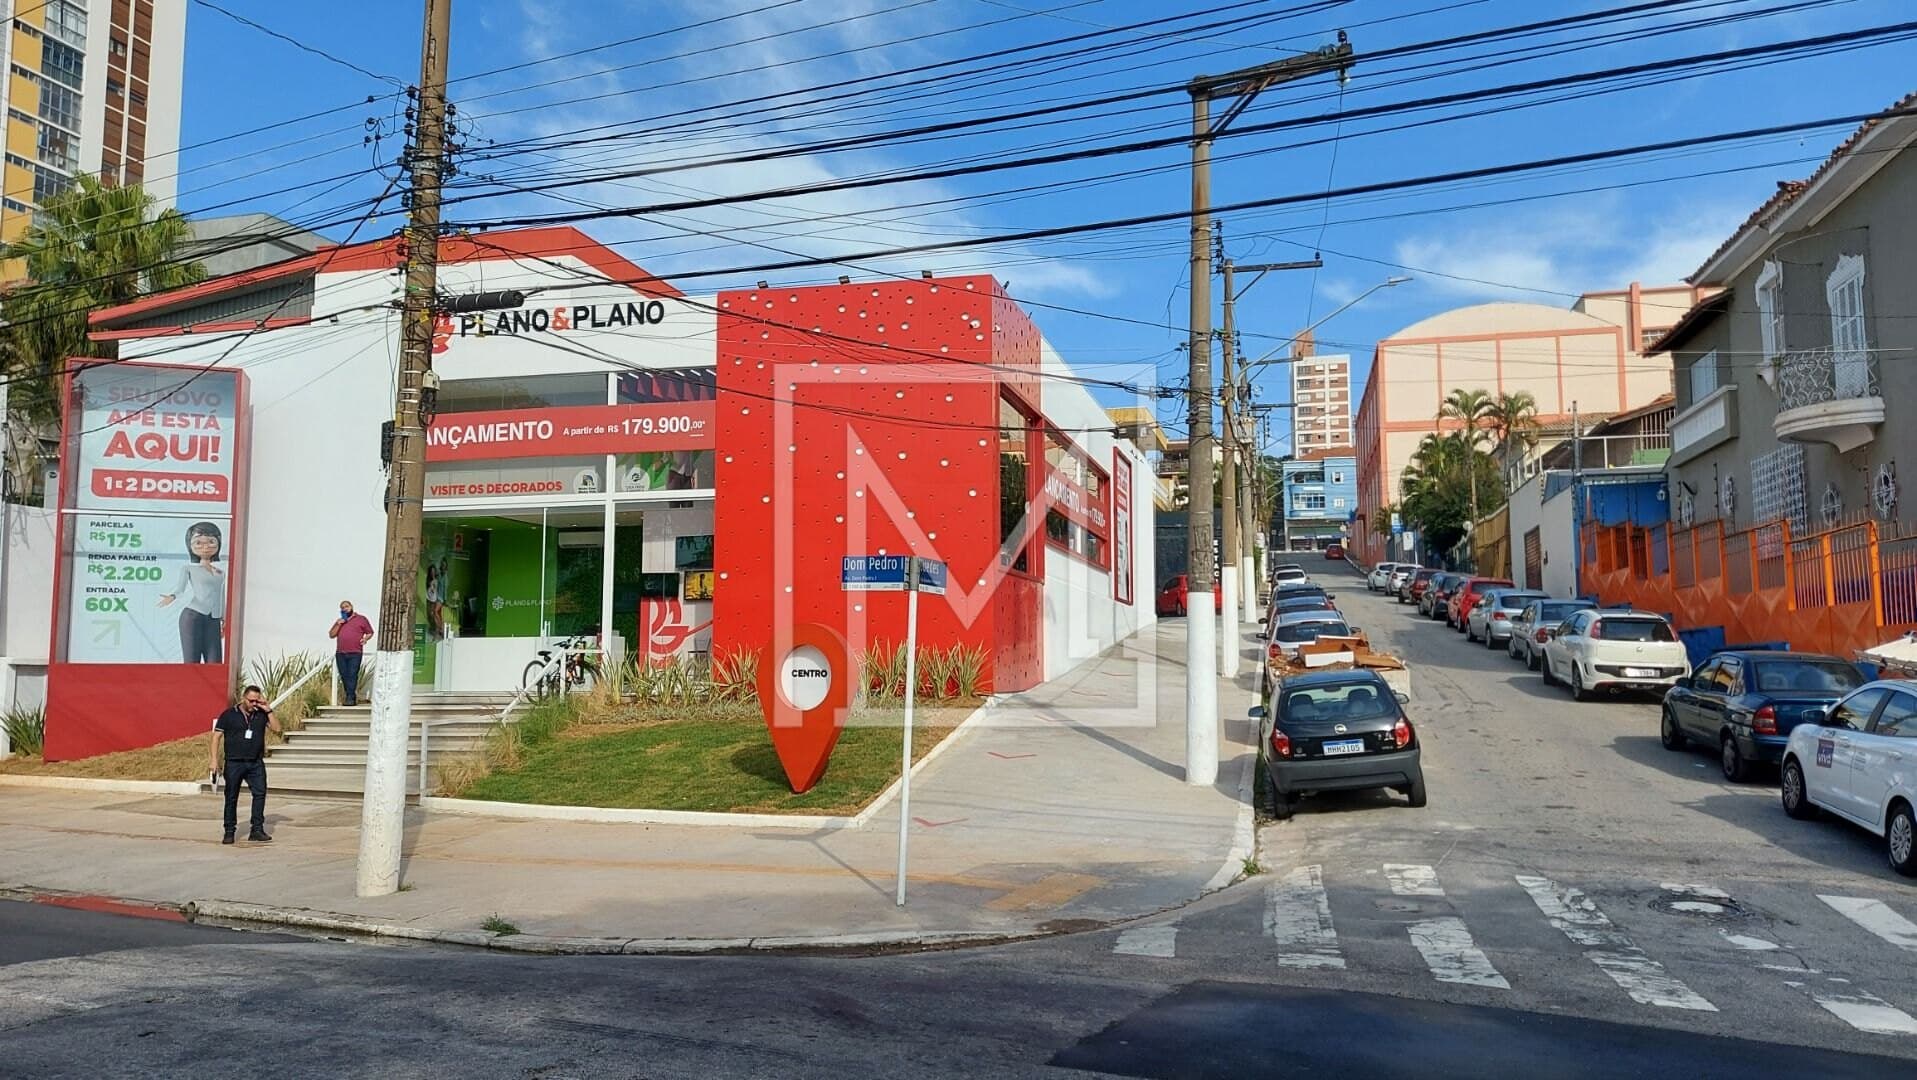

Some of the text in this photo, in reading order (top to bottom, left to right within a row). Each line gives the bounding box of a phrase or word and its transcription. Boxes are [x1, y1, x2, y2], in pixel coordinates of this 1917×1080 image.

[108, 386, 221, 407] SEU NOVO
[161, 409, 221, 430] ESTÁ
[426, 420, 553, 450] NÇAMENTO
[563, 427, 570, 435] A
[570, 426, 592, 436] partir
[594, 426, 605, 434] de
[607, 425, 619, 433] R$
[103, 430, 221, 463] AQUI!
[103, 476, 113, 491] 1
[125, 477, 138, 492] 2
[141, 478, 220, 495] DORMS.
[430, 481, 563, 496] VISITE OS DECORADOS
[90, 521, 134, 529] PARCELAS
[88, 553, 117, 561] RENDA
[844, 557, 866, 571] Dom
[869, 556, 898, 570] Pedro
[86, 586, 126, 594] ENTRADA
[85, 597, 129, 612] 60X
[791, 669, 828, 678] CENTRO
